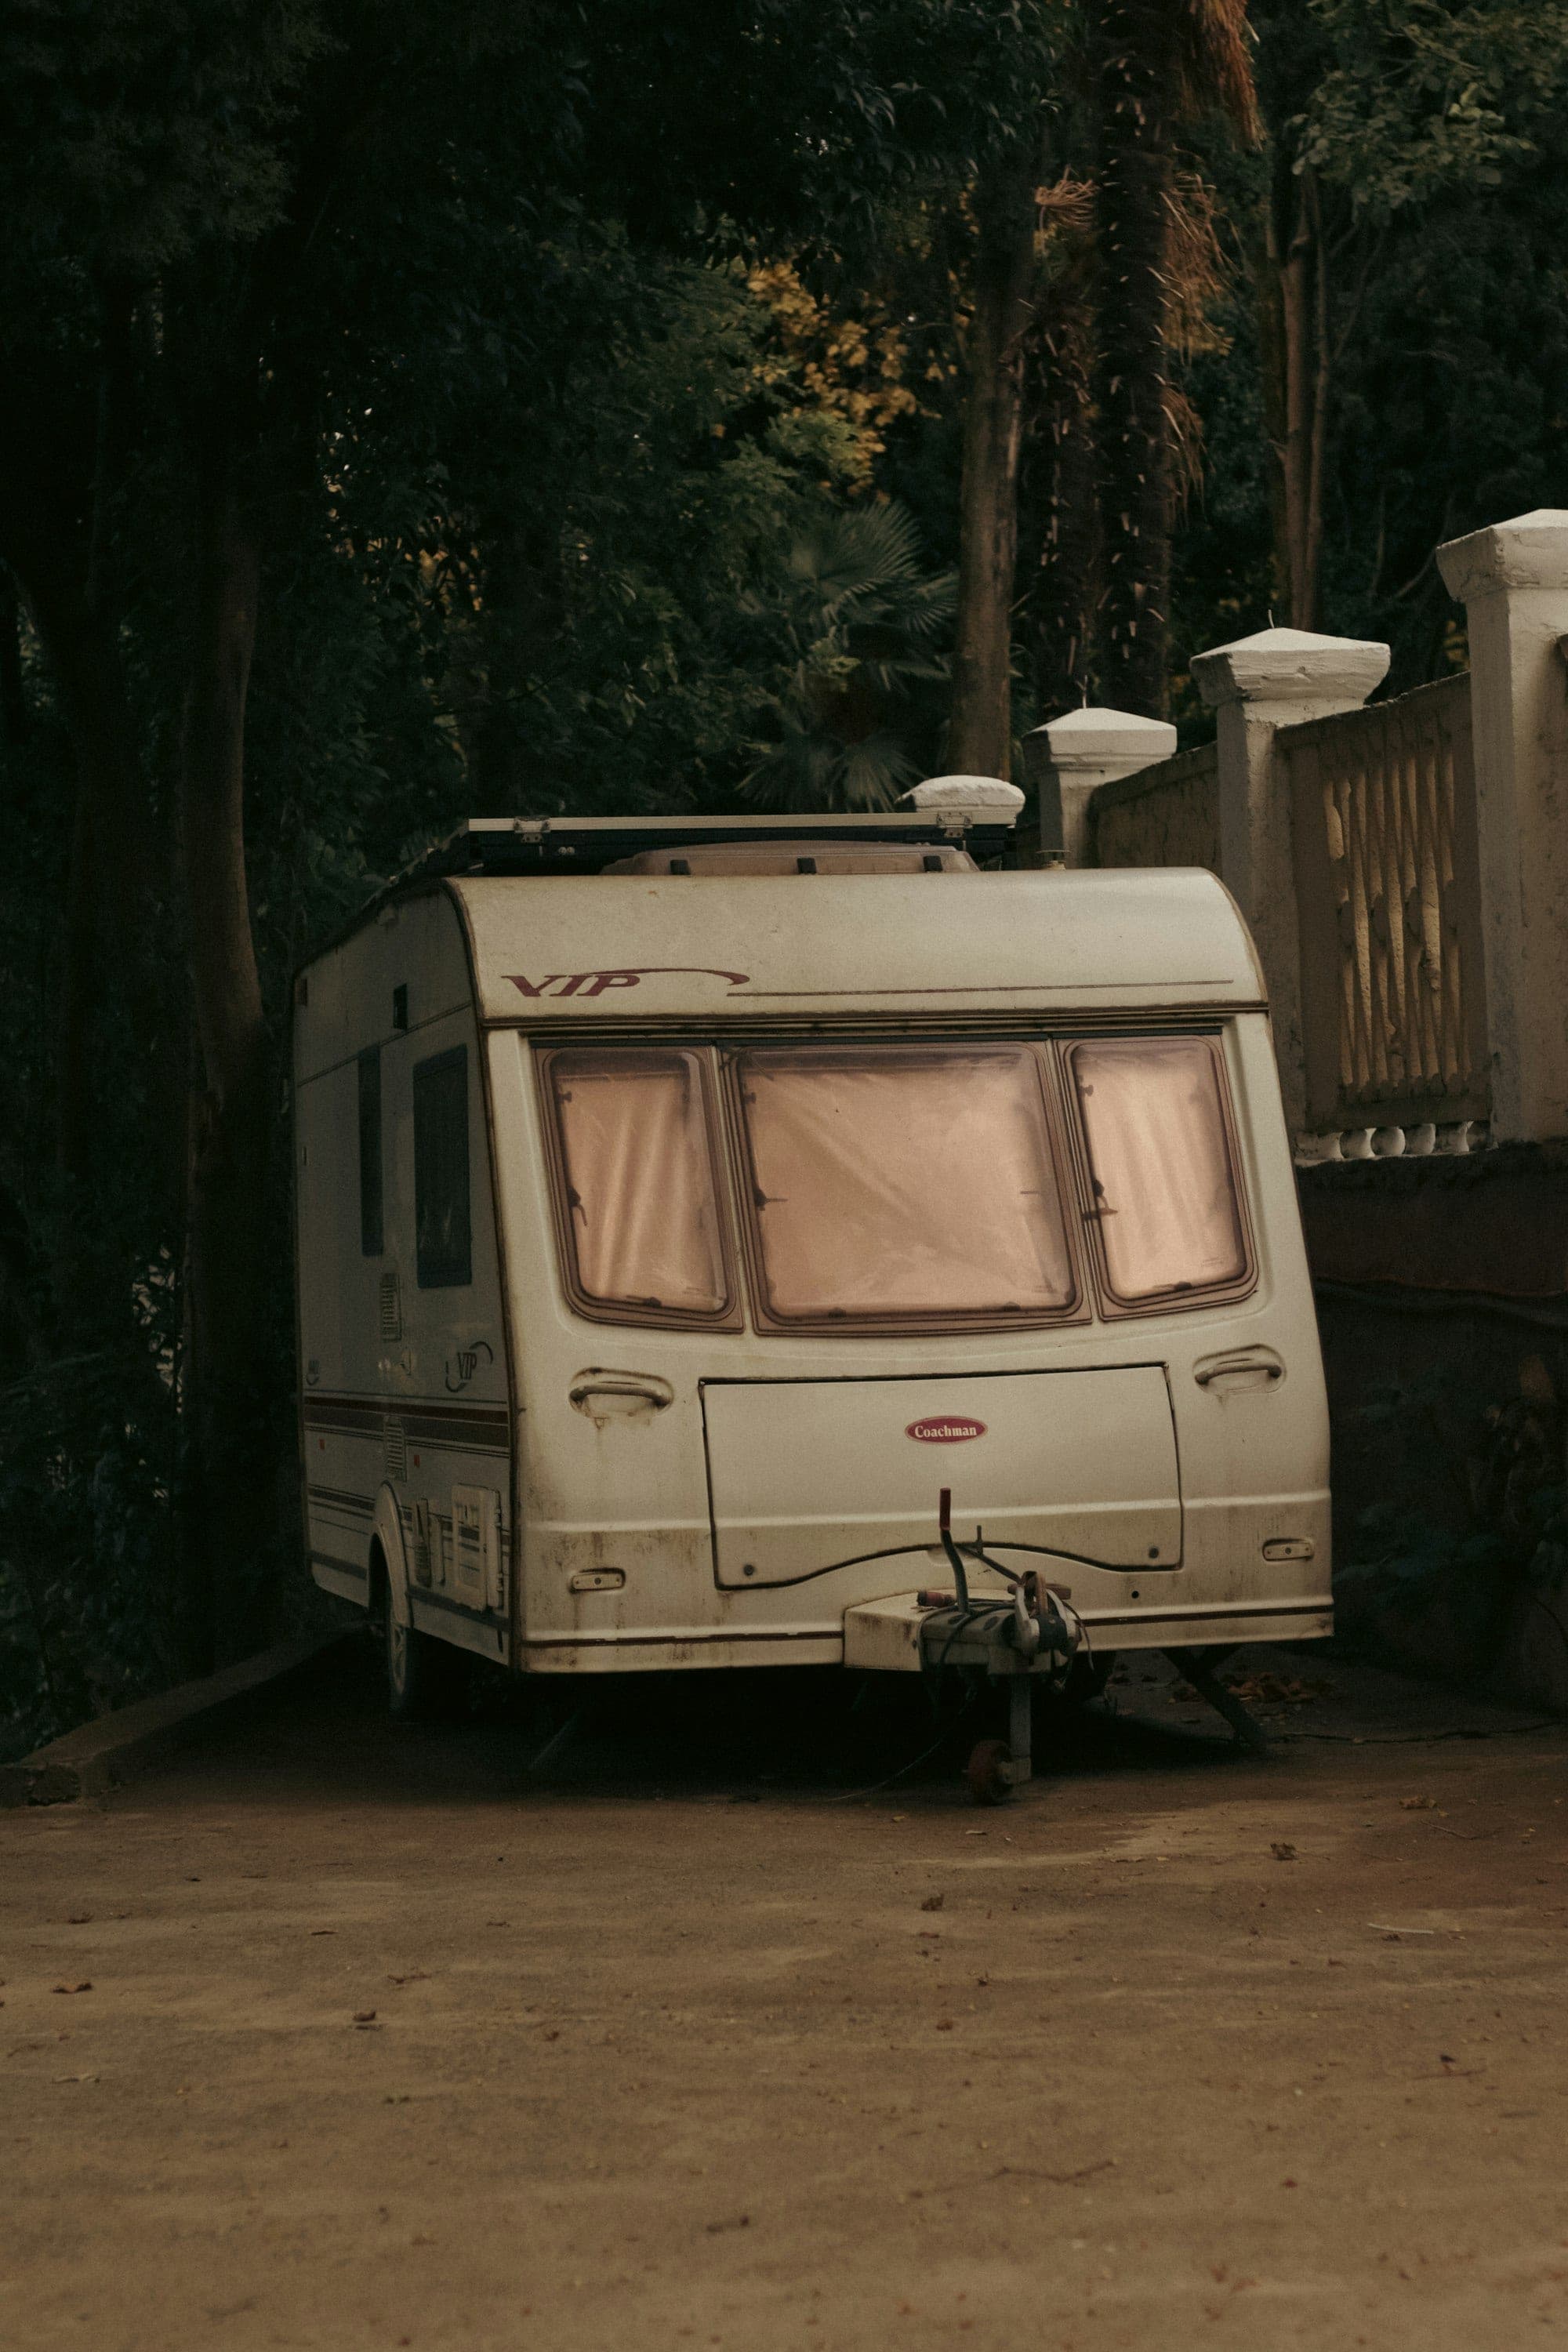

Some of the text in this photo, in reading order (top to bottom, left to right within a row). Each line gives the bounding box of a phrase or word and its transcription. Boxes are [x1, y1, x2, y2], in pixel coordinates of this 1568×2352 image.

[501, 974, 641, 997] VIP
[457, 1352, 477, 1380] VIP
[914, 1425, 978, 1438] Coachman
